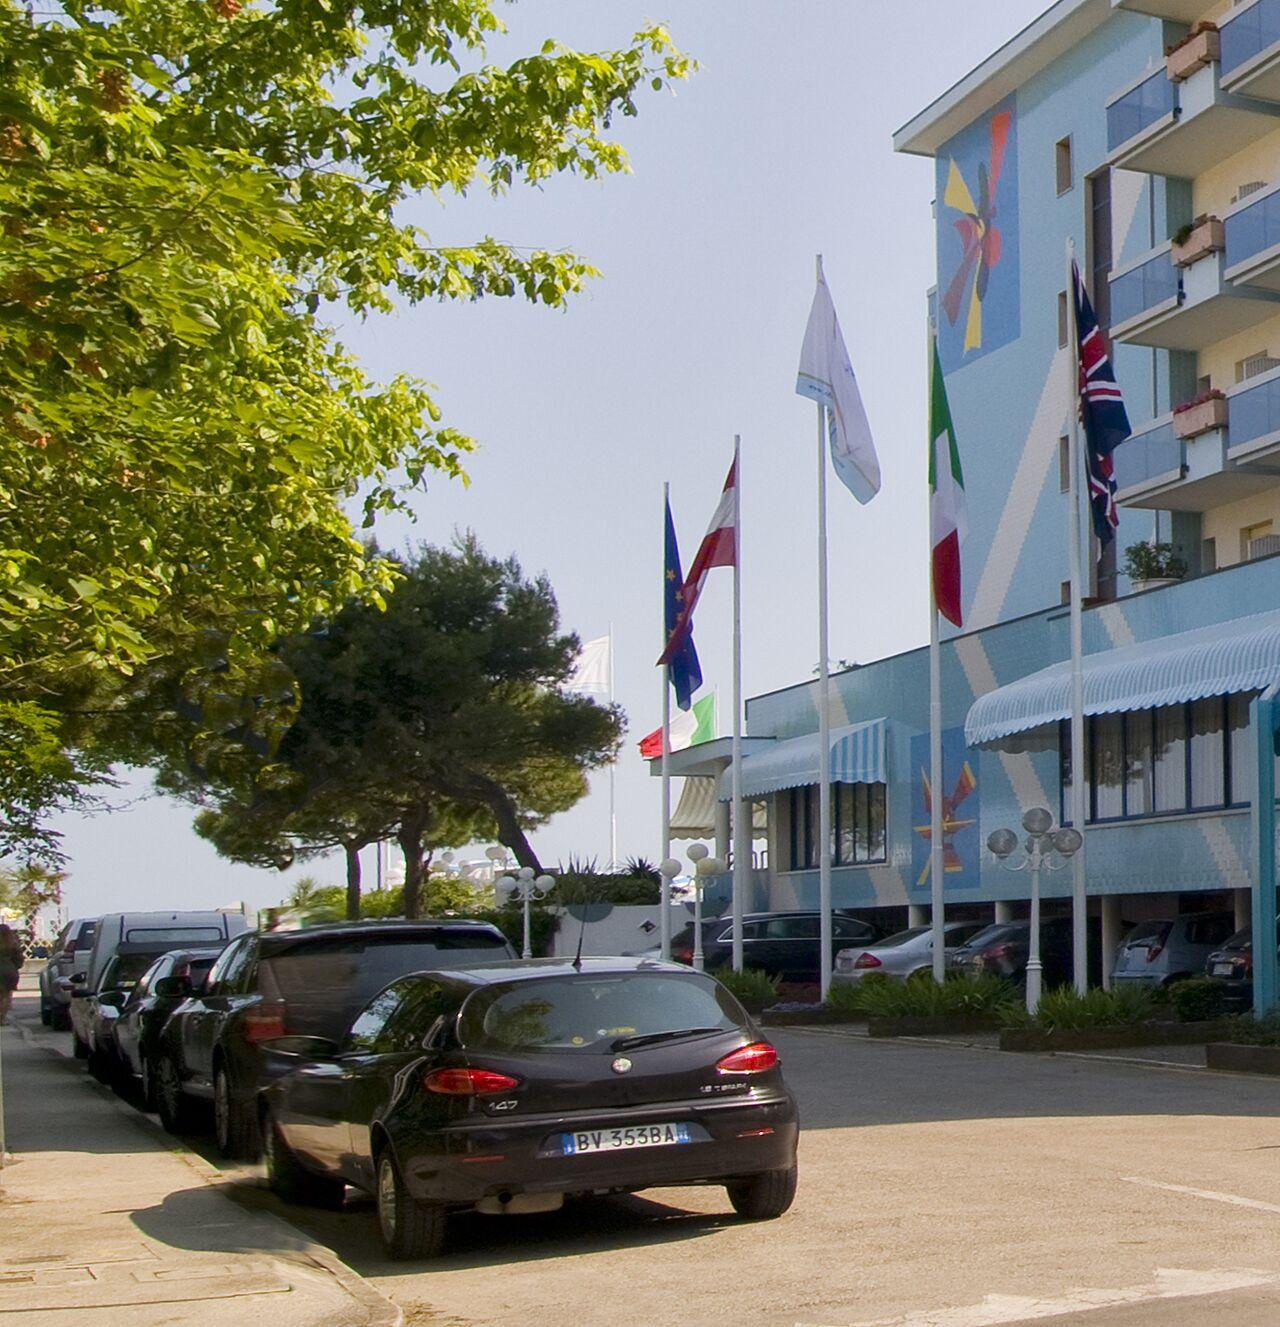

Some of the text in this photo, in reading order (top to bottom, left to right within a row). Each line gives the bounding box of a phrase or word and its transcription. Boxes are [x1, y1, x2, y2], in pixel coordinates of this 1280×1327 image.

[488, 1100, 518, 1111] 147
[577, 1125, 675, 1151] BV 353BA
